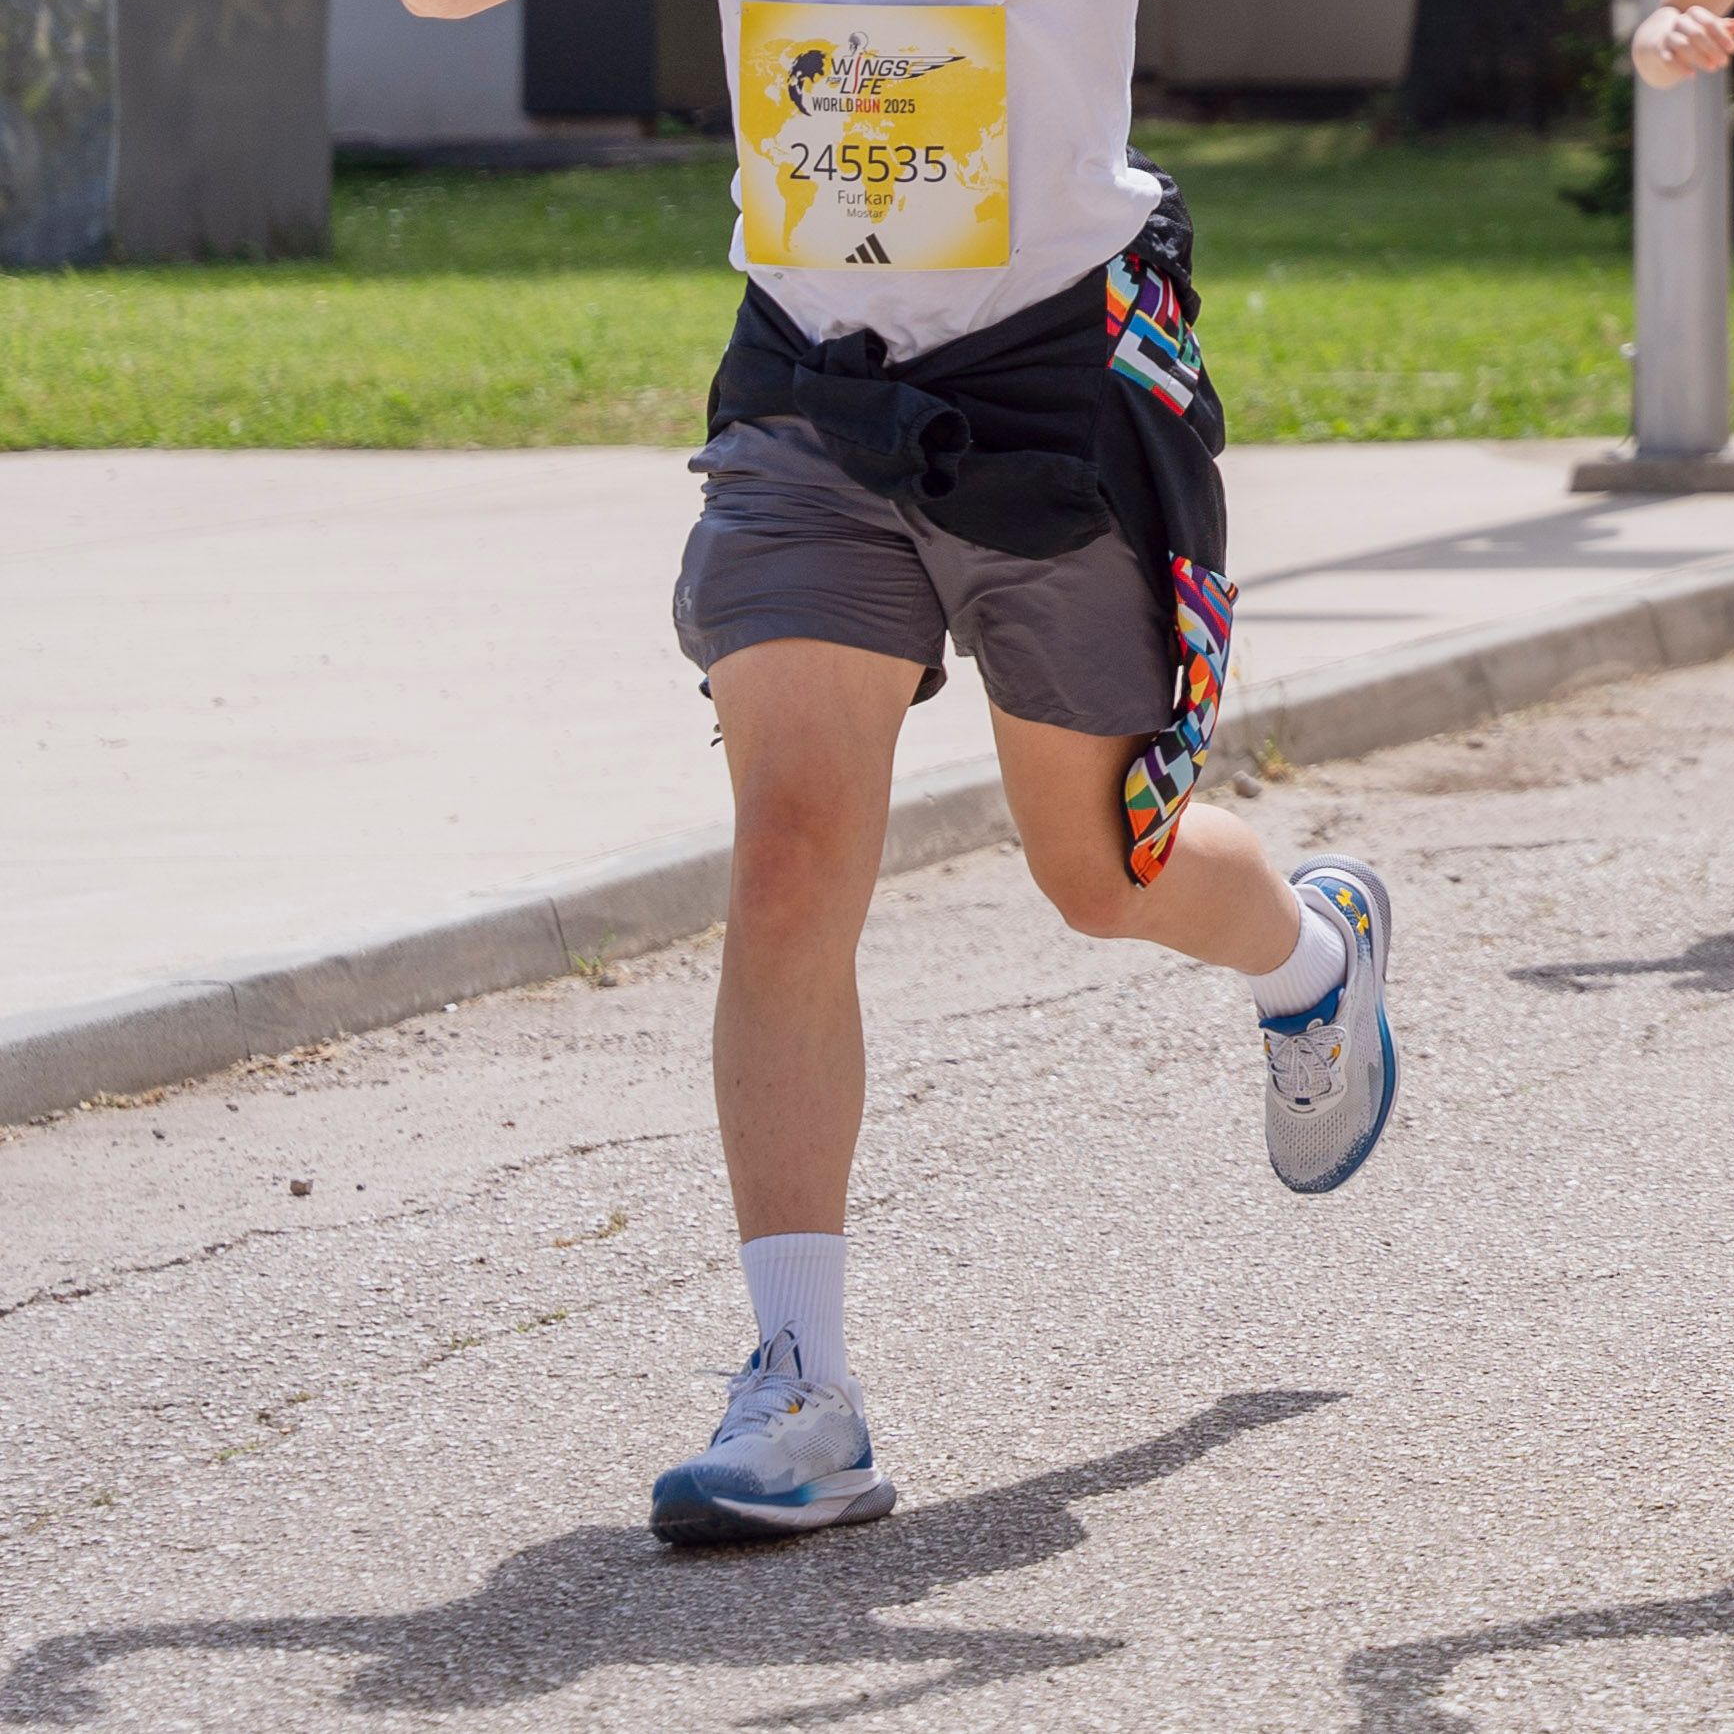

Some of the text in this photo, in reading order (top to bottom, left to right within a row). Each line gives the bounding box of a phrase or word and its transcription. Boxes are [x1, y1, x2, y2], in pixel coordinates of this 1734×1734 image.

[831, 55, 910, 77] WINGS
[840, 78, 882, 95] LIFE
[884, 98, 915, 114] 2025
[789, 142, 947, 183] 245535
[837, 190, 894, 206] Furkan
[846, 208, 883, 218] Mostar
